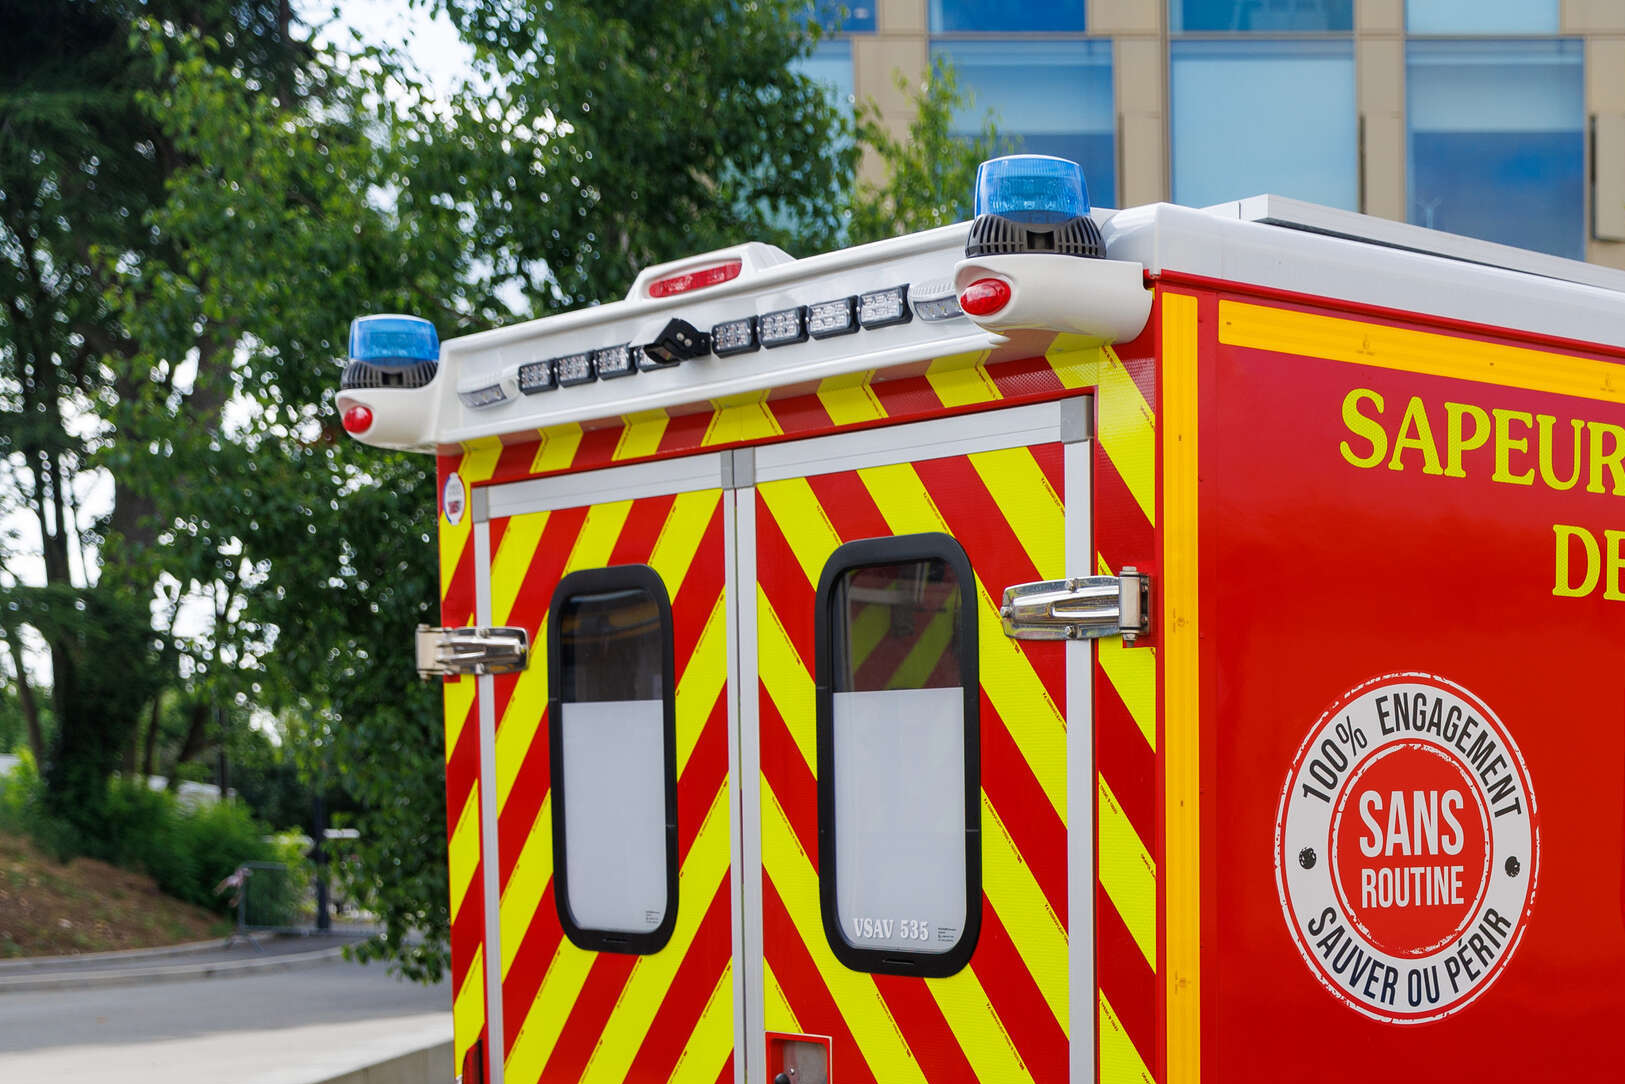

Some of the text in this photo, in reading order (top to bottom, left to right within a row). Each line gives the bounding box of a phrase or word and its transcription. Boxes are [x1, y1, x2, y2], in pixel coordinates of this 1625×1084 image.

[1302, 692, 1522, 818] 100% ENGAGEMENT
[1359, 789, 1465, 858] SANS
[1361, 865, 1465, 909] ROUTINE
[853, 917, 894, 940] VSAV
[900, 919, 929, 942] 535
[1307, 906, 1512, 1008] SAUVER OU PÉRIR
